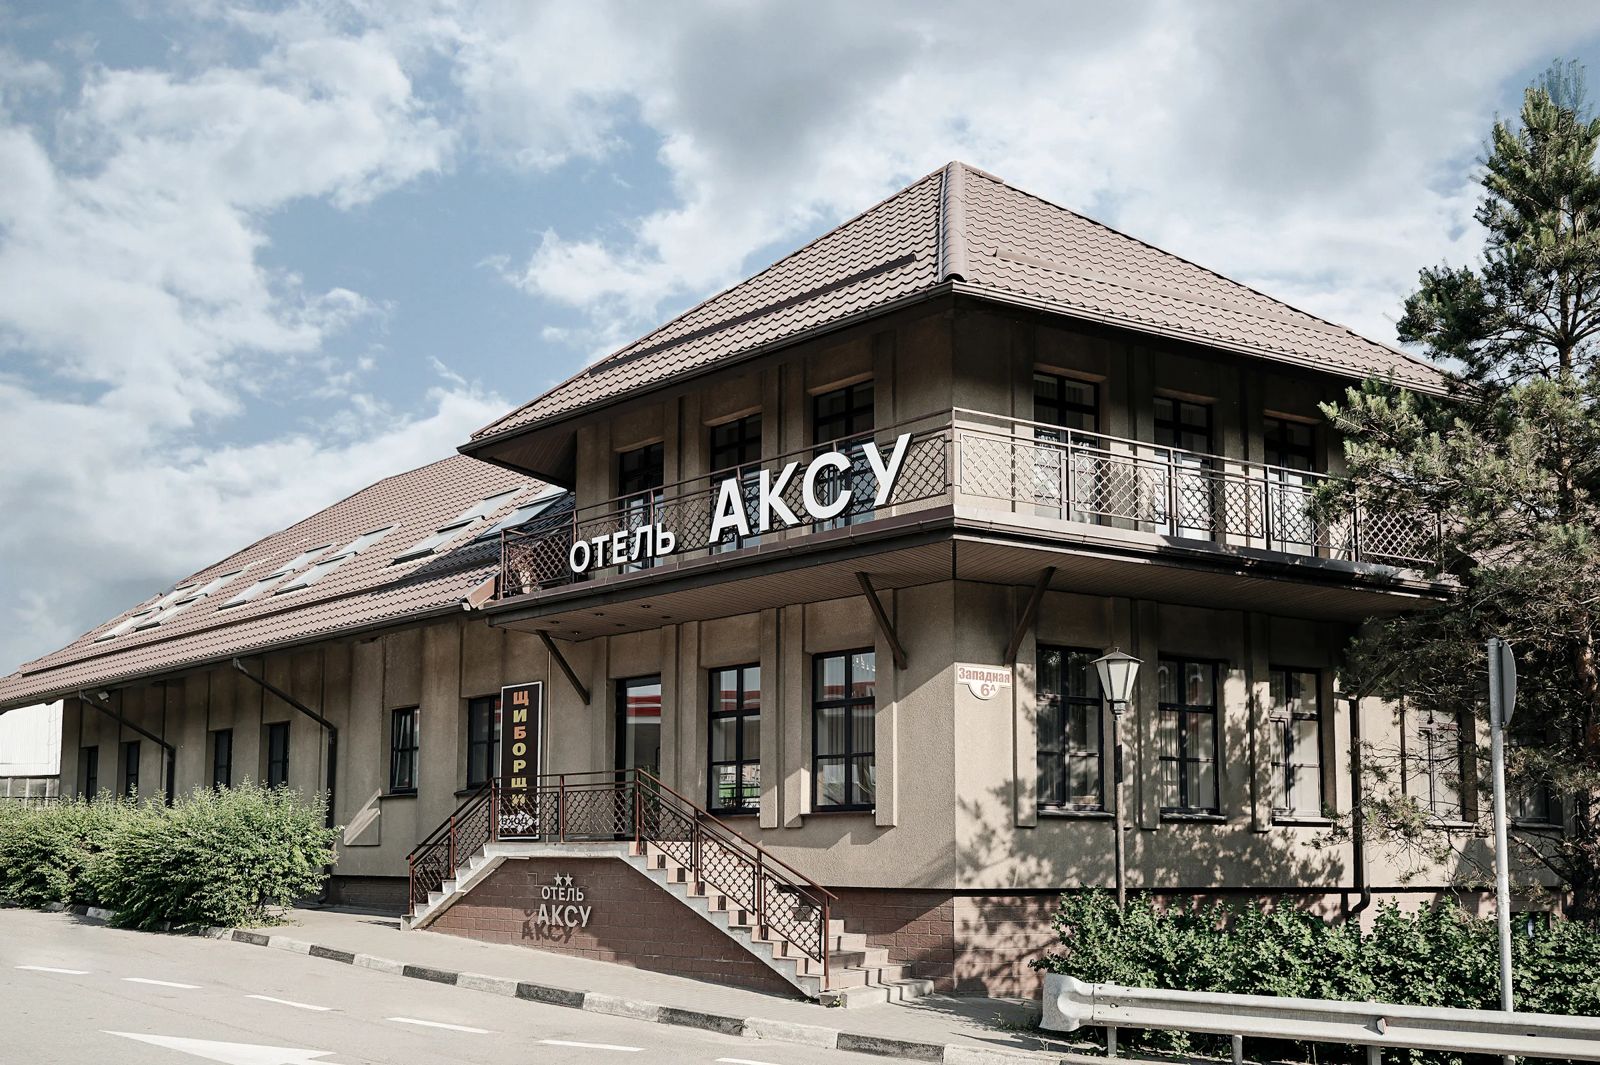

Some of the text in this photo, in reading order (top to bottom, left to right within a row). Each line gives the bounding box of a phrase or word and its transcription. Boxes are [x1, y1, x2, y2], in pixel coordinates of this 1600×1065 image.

[569, 432, 912, 573] ОТЕЛЬ АКСУ
[958, 667, 1010, 682] Западная
[541, 886, 584, 901] ОТЕЛЬ
[537, 903, 592, 928] АКСУ
